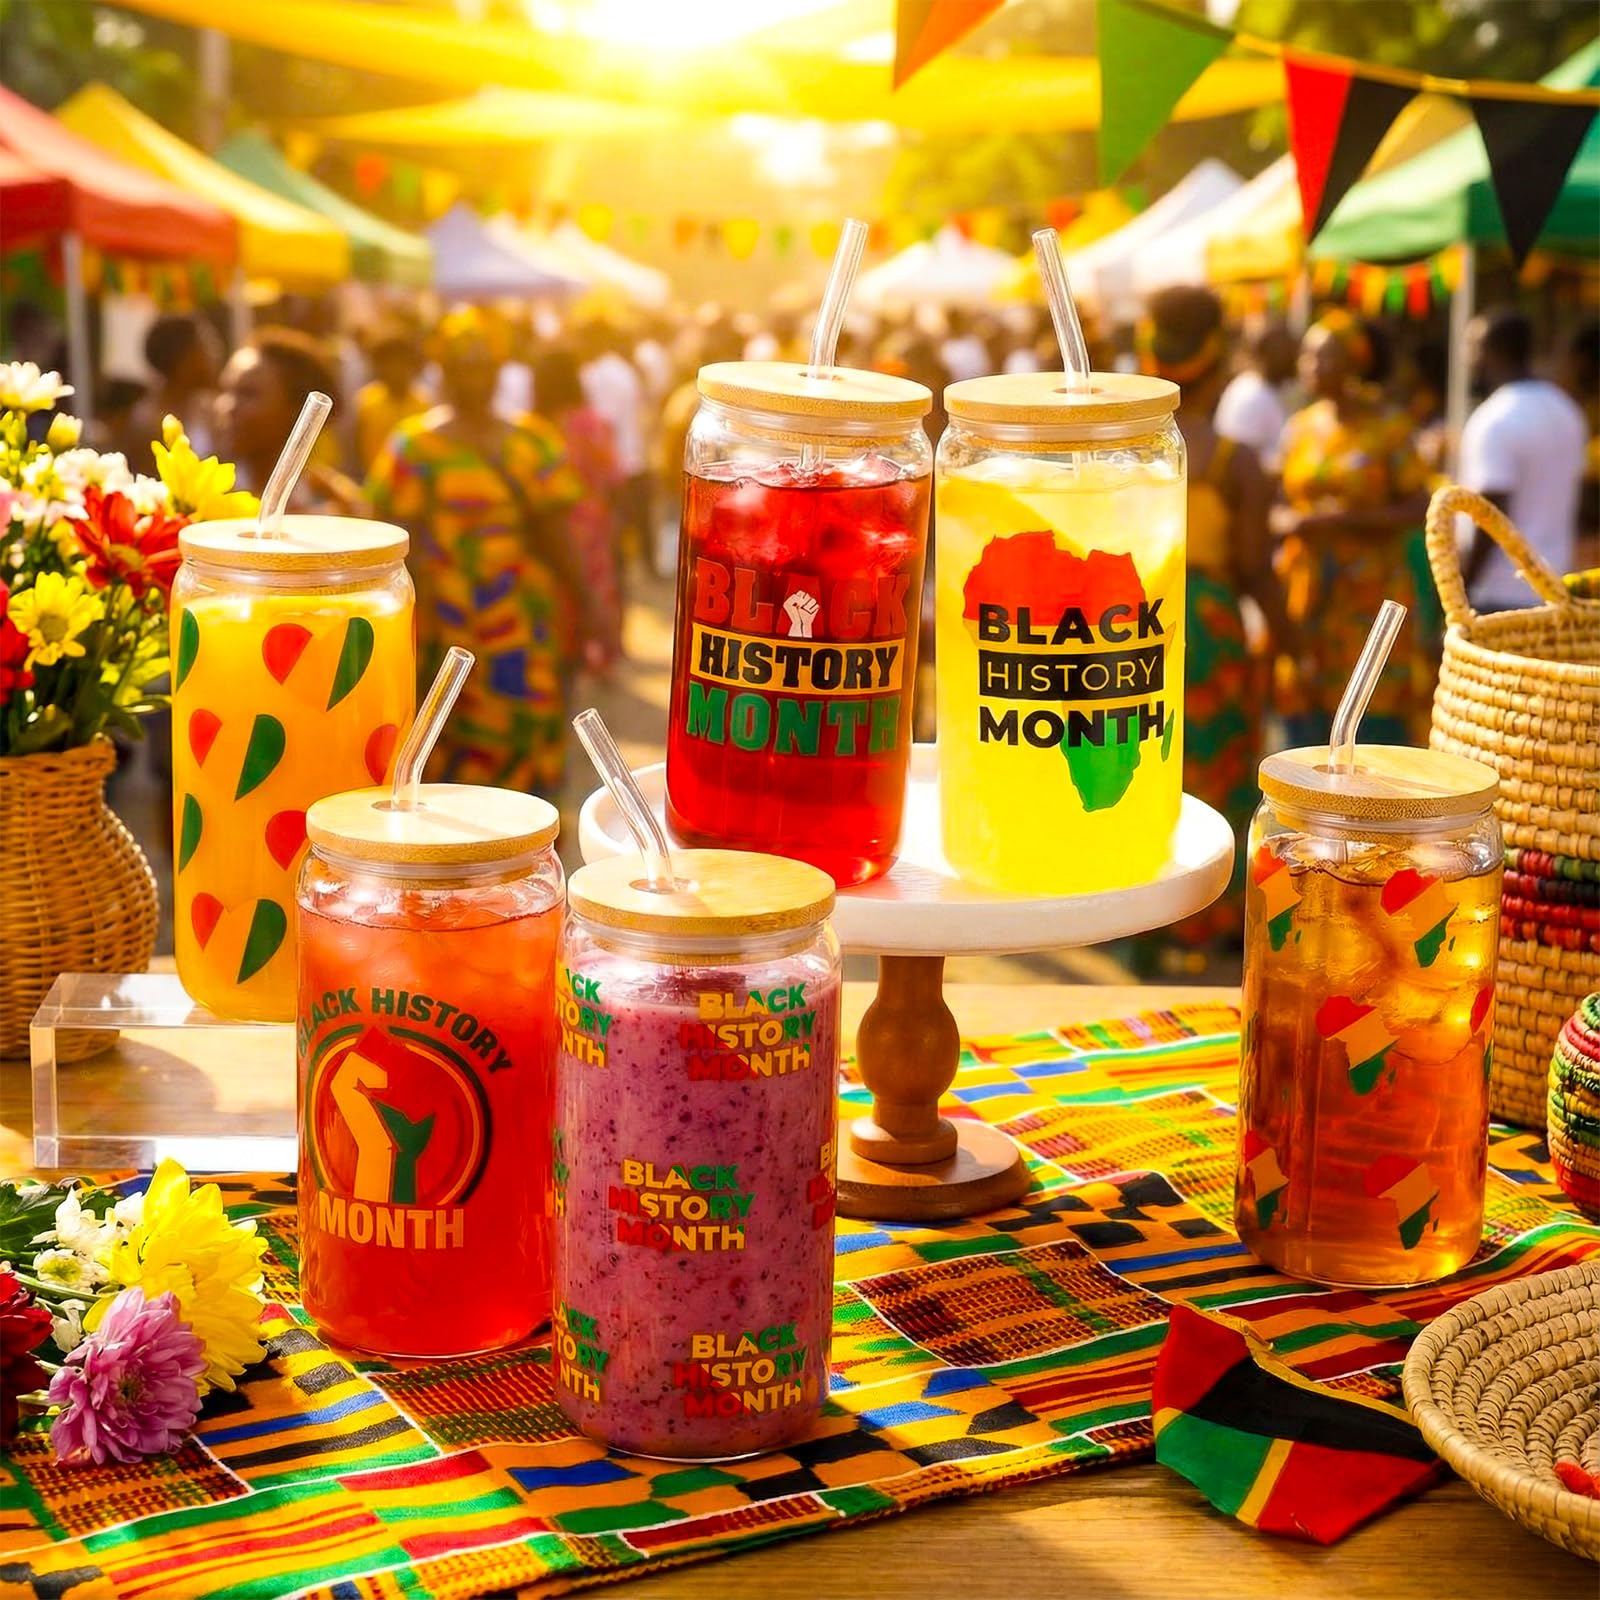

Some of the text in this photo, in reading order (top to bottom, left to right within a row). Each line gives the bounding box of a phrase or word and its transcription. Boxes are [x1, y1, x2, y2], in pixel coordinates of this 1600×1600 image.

[694, 556, 910, 639] BLACK
[979, 598, 1164, 644] BLACK
[699, 632, 899, 690] HISTORY
[987, 656, 1158, 692] HISTORY
[686, 680, 901, 756] MONTH
[979, 700, 1164, 748] MONTH
[556, 966, 601, 1005] ACK
[699, 982, 807, 1019] BLACK
[371, 988, 513, 1074] HISTORY
[557, 992, 612, 1038] TORY
[680, 1010, 816, 1050] HISTORY
[561, 1021, 605, 1068] NTH
[688, 1044, 811, 1081] MONTH
[623, 1159, 738, 1190] BLACK
[319, 1190, 464, 1250] MONTH
[609, 1186, 755, 1220] HISTORY
[618, 1217, 745, 1251] MONTH
[556, 1301, 597, 1342] ACK
[692, 1324, 796, 1358] BLACK
[556, 1325, 608, 1374] TORY
[674, 1347, 807, 1389] HISTORY
[560, 1359, 600, 1402] NTH
[684, 1379, 801, 1418] MONTH
